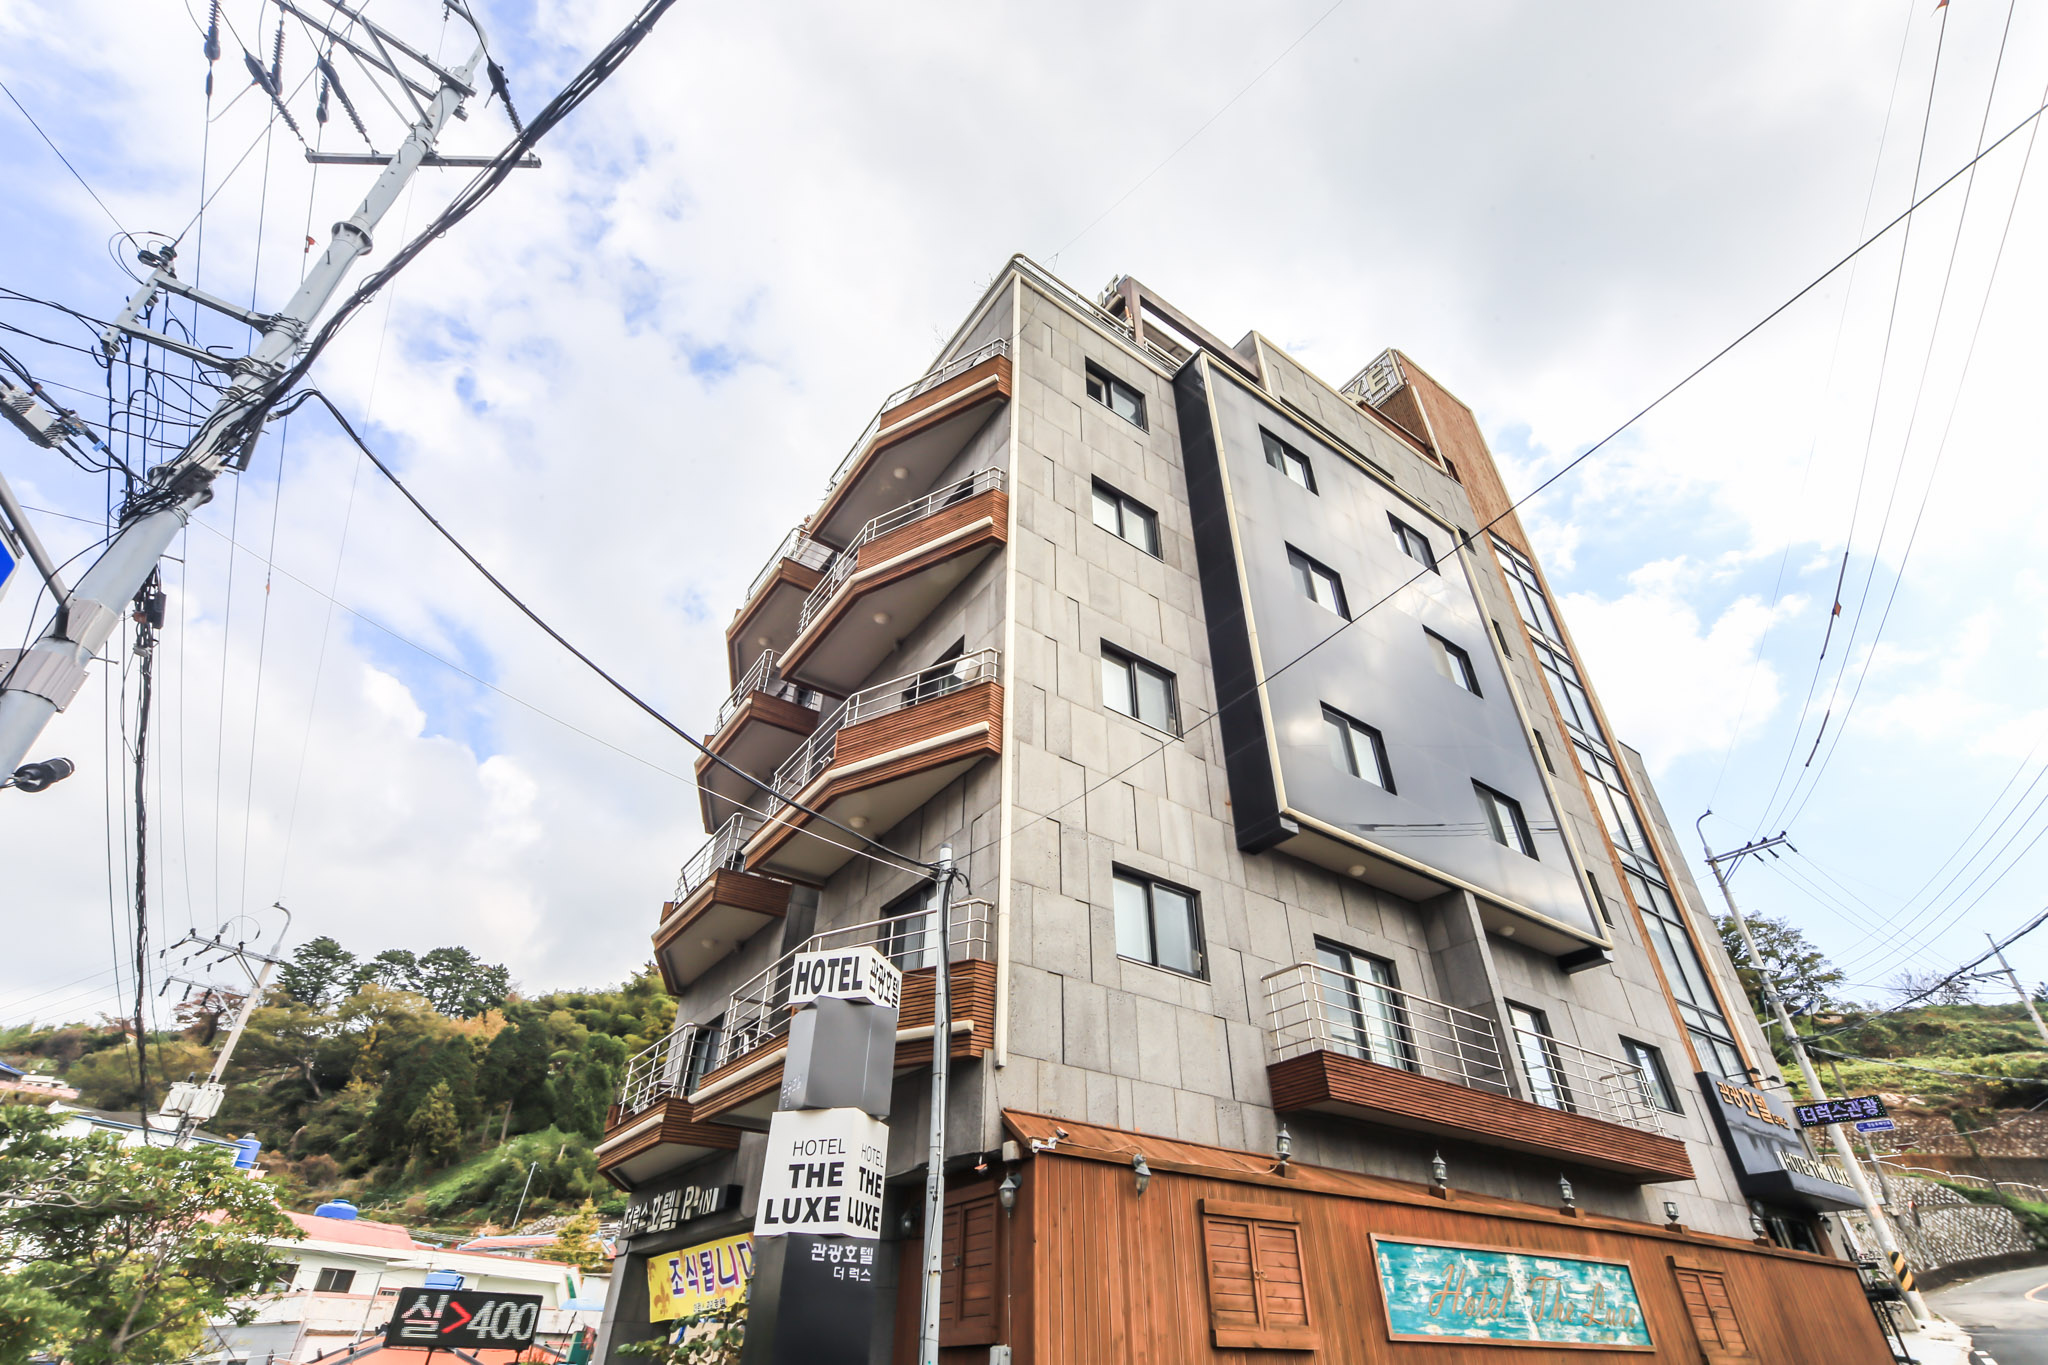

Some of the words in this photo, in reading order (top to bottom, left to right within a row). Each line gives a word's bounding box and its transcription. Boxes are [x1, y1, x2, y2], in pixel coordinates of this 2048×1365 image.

[794, 956, 862, 996] HOTEL
[869, 957, 899, 1008] 관광호텔
[1716, 1081, 1774, 1125] 관광호텔
[793, 1138, 846, 1156] HOTEL
[861, 1143, 884, 1168] HOTEL
[788, 1162, 844, 1189] THE
[859, 1166, 883, 1199] THE
[764, 1196, 841, 1224] LUXE
[847, 1197, 880, 1232] LUXE
[811, 1243, 873, 1265] 관광호텔
[1429, 1264, 1513, 1319] Hotel
[1529, 1274, 1575, 1323] The
[1581, 1282, 1636, 1328] Luxe
